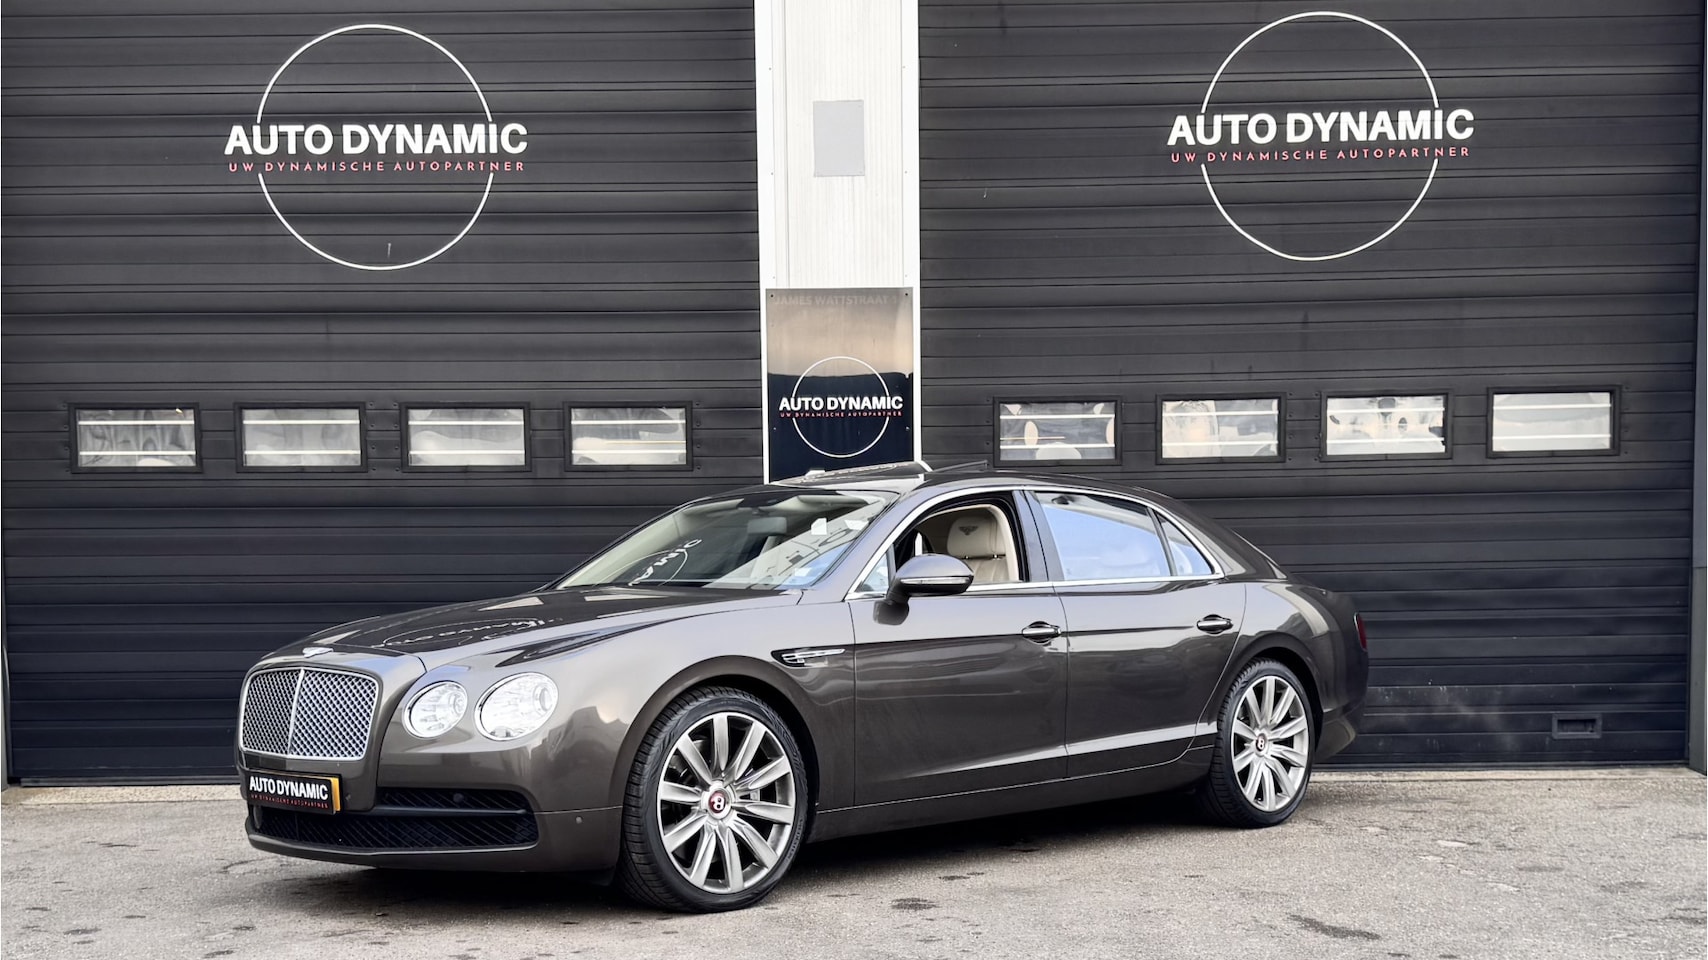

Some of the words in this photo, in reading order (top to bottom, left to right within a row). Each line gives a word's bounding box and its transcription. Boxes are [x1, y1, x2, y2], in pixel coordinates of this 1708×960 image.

[1167, 113, 1278, 146] AUTO
[1286, 109, 1475, 144] DYNAMIC
[224, 124, 334, 155] AUTO
[342, 123, 528, 154] DYNAMIC
[1171, 152, 1197, 163] UW
[1207, 150, 1328, 162] DYNAMISCHE
[1337, 147, 1470, 160] AUTOPARTNER
[229, 162, 254, 172] UW
[265, 161, 386, 172] DYNAMISCHE
[394, 161, 525, 172] AUTOPARTNER
[775, 295, 812, 305] JAMES
[779, 396, 825, 411] AUTO
[827, 396, 904, 410] DYNAMIC
[249, 775, 277, 794] AUTO
[276, 779, 329, 800] DYNAMIC
